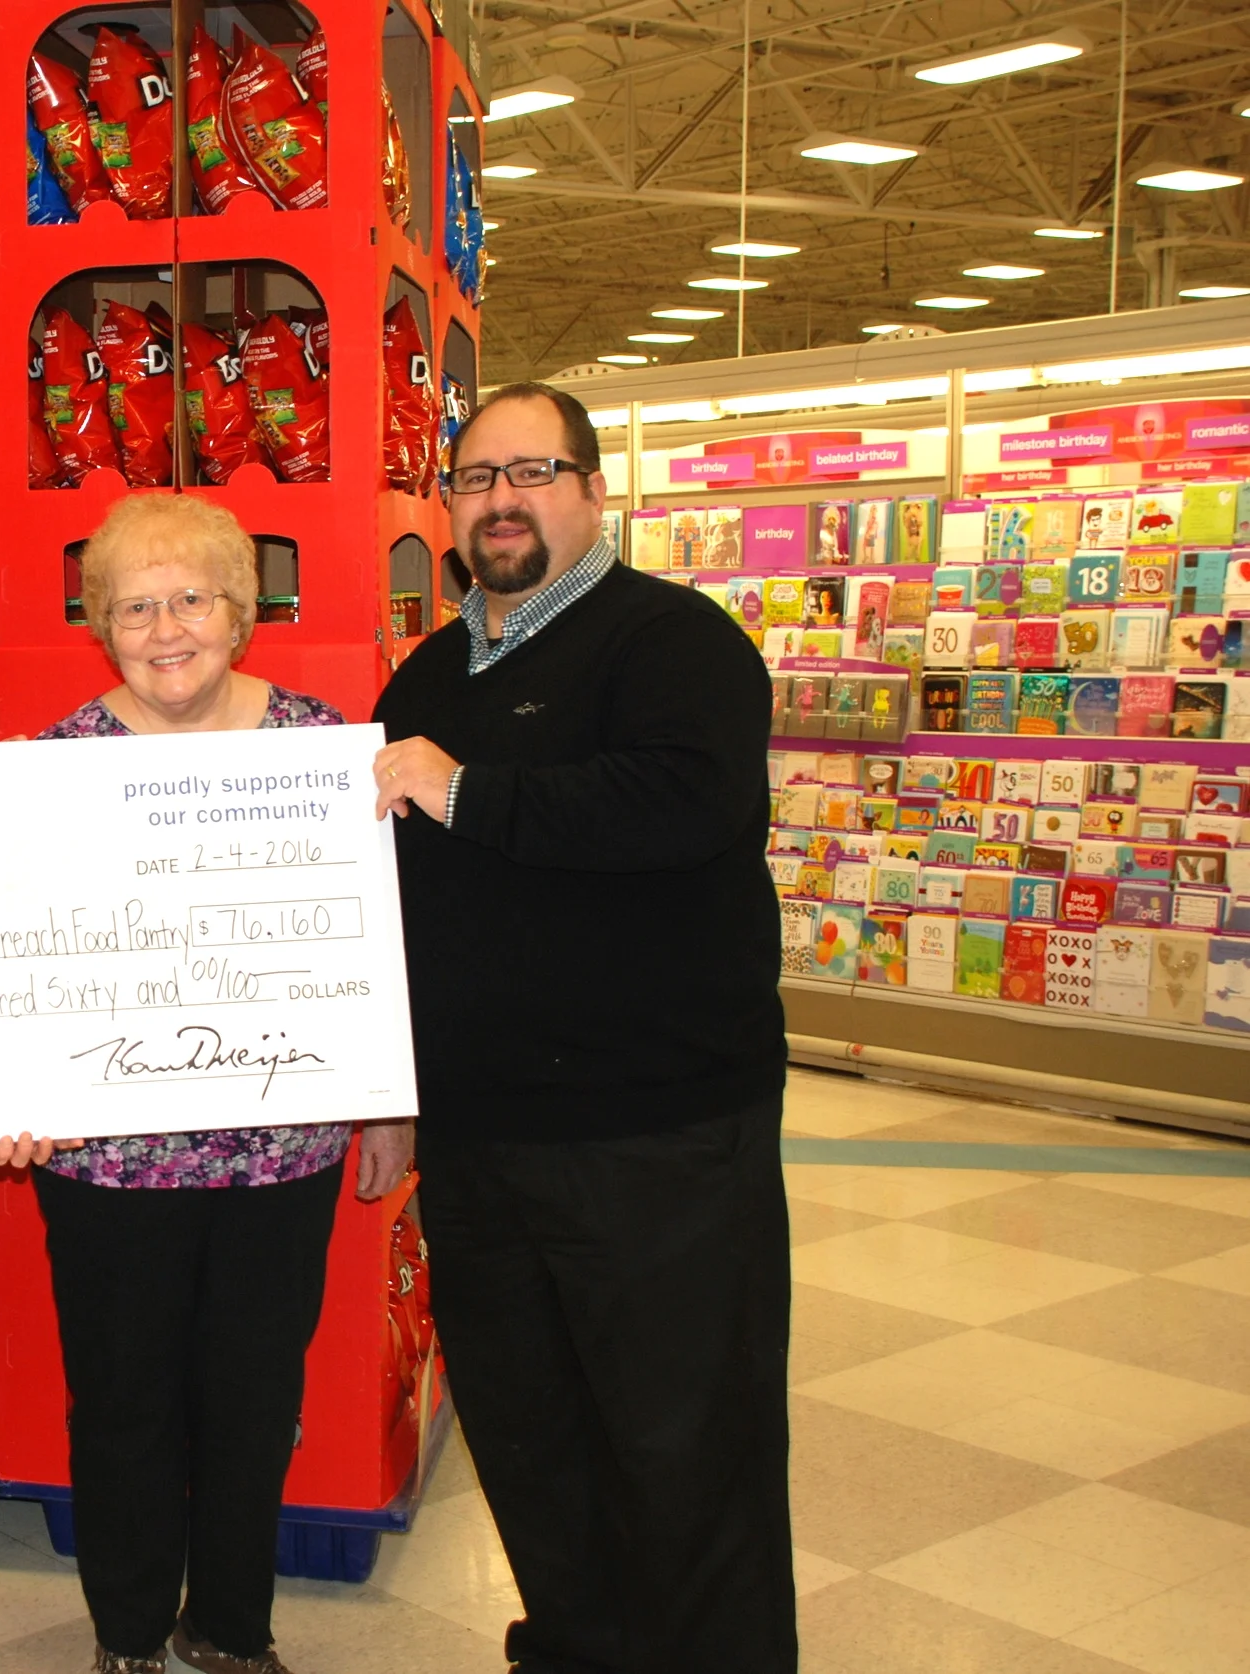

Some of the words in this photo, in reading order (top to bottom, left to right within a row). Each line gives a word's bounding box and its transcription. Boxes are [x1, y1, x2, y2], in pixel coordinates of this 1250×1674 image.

[1191, 423, 1249, 438] romantic
[1002, 437, 1056, 452] milestone
[1058, 433, 1108, 448] birthday
[815, 452, 854, 466] belated
[855, 449, 899, 463] birthday
[1157, 463, 1172, 471] her
[1173, 460, 1212, 471] birthday
[691, 462, 728, 474] birthday
[1001, 473, 1015, 482] her
[1016, 470, 1052, 482] birthday
[755, 529, 793, 541] birthday
[1078, 566, 1109, 596] 18
[1126, 566, 1165, 595] 18
[933, 627, 958, 653] 30
[1063, 621, 1098, 655] 50
[794, 660, 817, 668] limited
[818, 661, 840, 669] edition
[1032, 678, 1057, 696] 50
[124, 775, 211, 801] proudly
[221, 770, 351, 795] supporting
[1051, 775, 1074, 793] 50
[148, 808, 187, 826] our
[197, 800, 330, 823] community
[136, 859, 179, 876] DATE
[194, 838, 322, 871] 2-4-2016
[1088, 852, 1103, 865] 65
[1150, 851, 1168, 867] 65
[886, 880, 910, 899] 80
[71, 907, 119, 954] Food
[124, 898, 189, 966] Pantry
[923, 925, 942, 940] 90
[873, 931, 897, 955] 80
[48, 976, 117, 1022] Sixty
[137, 965, 182, 1007] and
[288, 980, 371, 1001] DOLLARS
